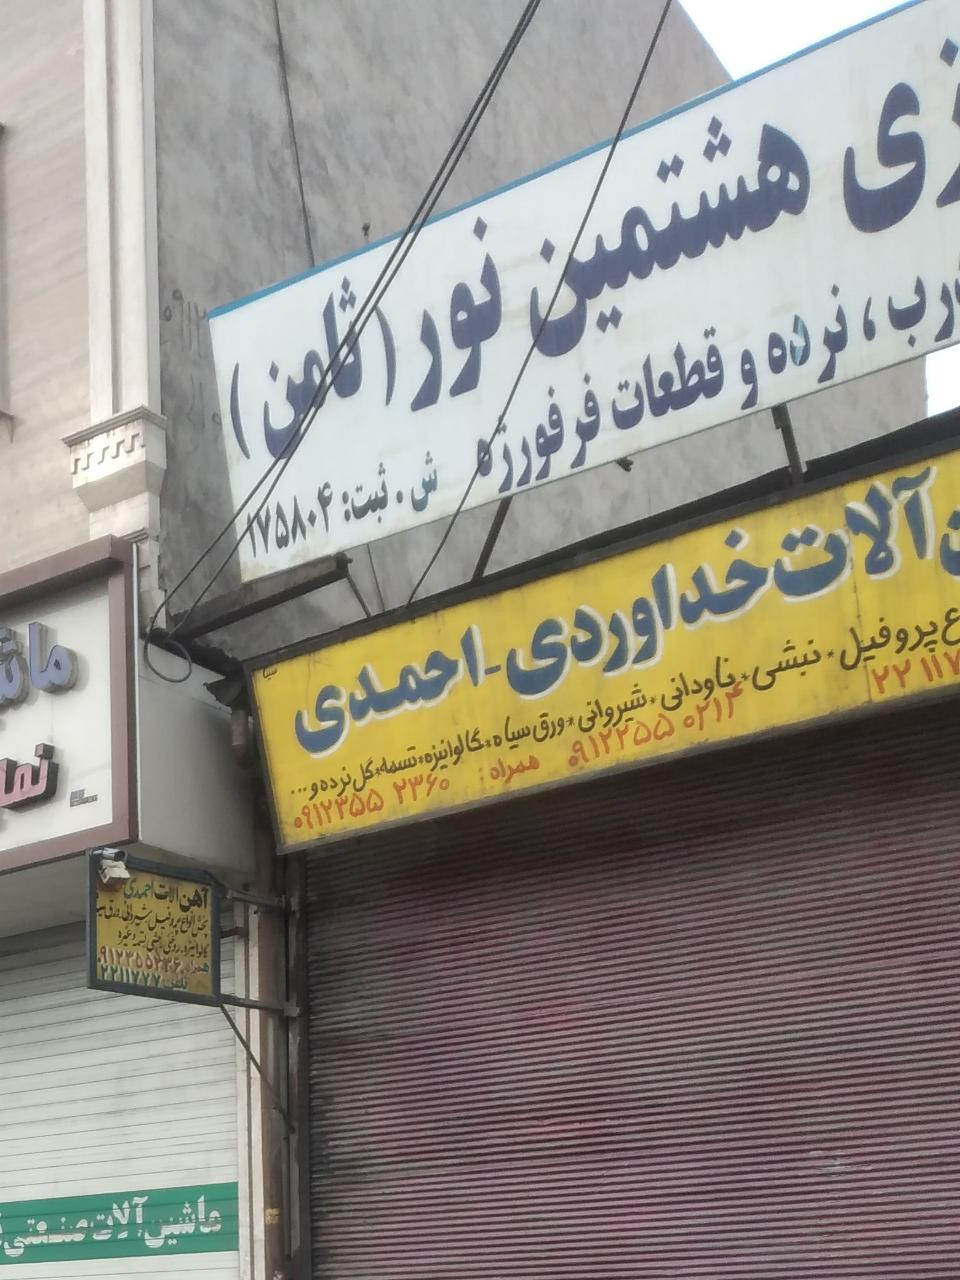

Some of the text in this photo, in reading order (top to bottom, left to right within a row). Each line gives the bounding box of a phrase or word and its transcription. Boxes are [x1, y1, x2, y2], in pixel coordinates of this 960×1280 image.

[530, 115, 810, 356] هشتمین
[411, 216, 502, 412] نور
[768, 284, 848, 383] نرده
[611, 326, 725, 430] قطعات
[740, 348, 759, 410] و
[246, 481, 333, 558] ۱۷۵۸۰۴
[506, 528, 774, 698] خداوردی
[841, 617, 938, 671] پروفیل
[295, 622, 487, 758] احمدی
[661, 656, 736, 711] ناودانی
[752, 639, 821, 690] نبشی
[578, 683, 648, 732] شیروانی
[3, 1216, 89, 1258] صنعتی
[145, 1194, 222, 1248] ماشین
